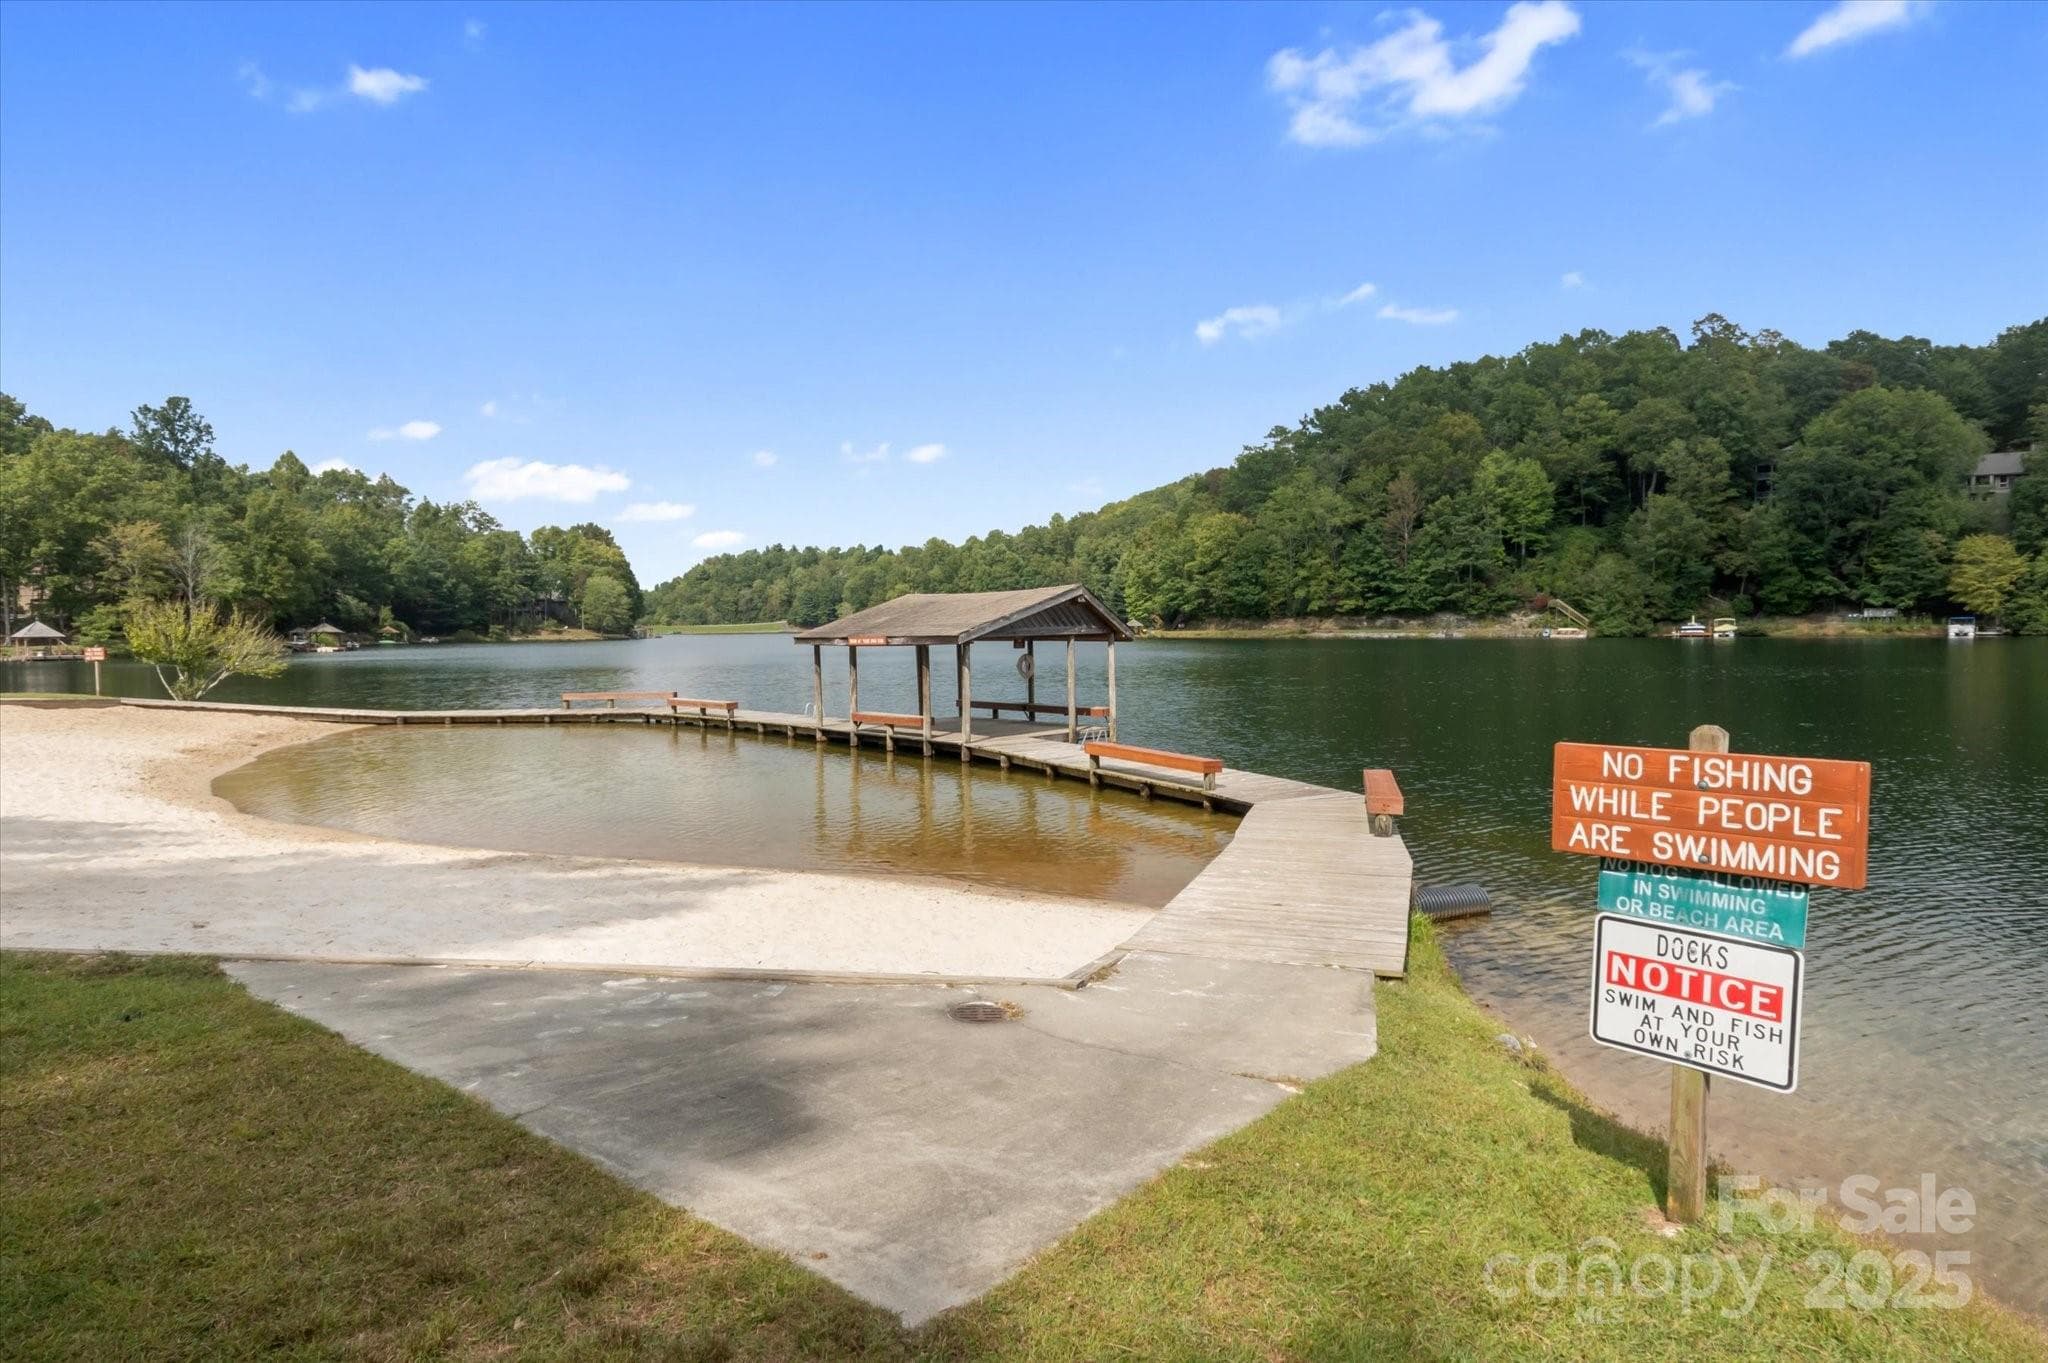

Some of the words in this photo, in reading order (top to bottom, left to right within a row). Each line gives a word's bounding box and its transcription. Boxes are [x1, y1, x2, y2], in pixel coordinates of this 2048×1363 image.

[1602, 751, 1643, 780] NO
[1668, 755, 1812, 795] FISHING
[1569, 785, 1672, 821] WHILE
[1697, 797, 1842, 840] PEOPLE
[1568, 822, 1631, 854] ARE
[1652, 831, 1840, 881] SWIMMING
[1603, 858, 1630, 872] NO
[1696, 871, 1805, 899] ALLOWED
[1633, 880, 1652, 896] IN
[1658, 884, 1766, 915] SWIMMING
[1616, 896, 1644, 914] OR
[1650, 903, 1718, 928] BEACH
[1724, 915, 1784, 940] AREA
[1656, 934, 1729, 970] DOCKS
[1610, 955, 1778, 1018] NOTICE
[1605, 989, 1657, 1013] SWIM
[1672, 1005, 1714, 1026] AND
[1731, 1018, 1783, 1045] FISH
[1640, 1014, 1664, 1030] AT
[1681, 1023, 1740, 1051] YOUR
[1634, 1029, 1678, 1052] OWN
[1694, 1045, 1744, 1071] RISK
